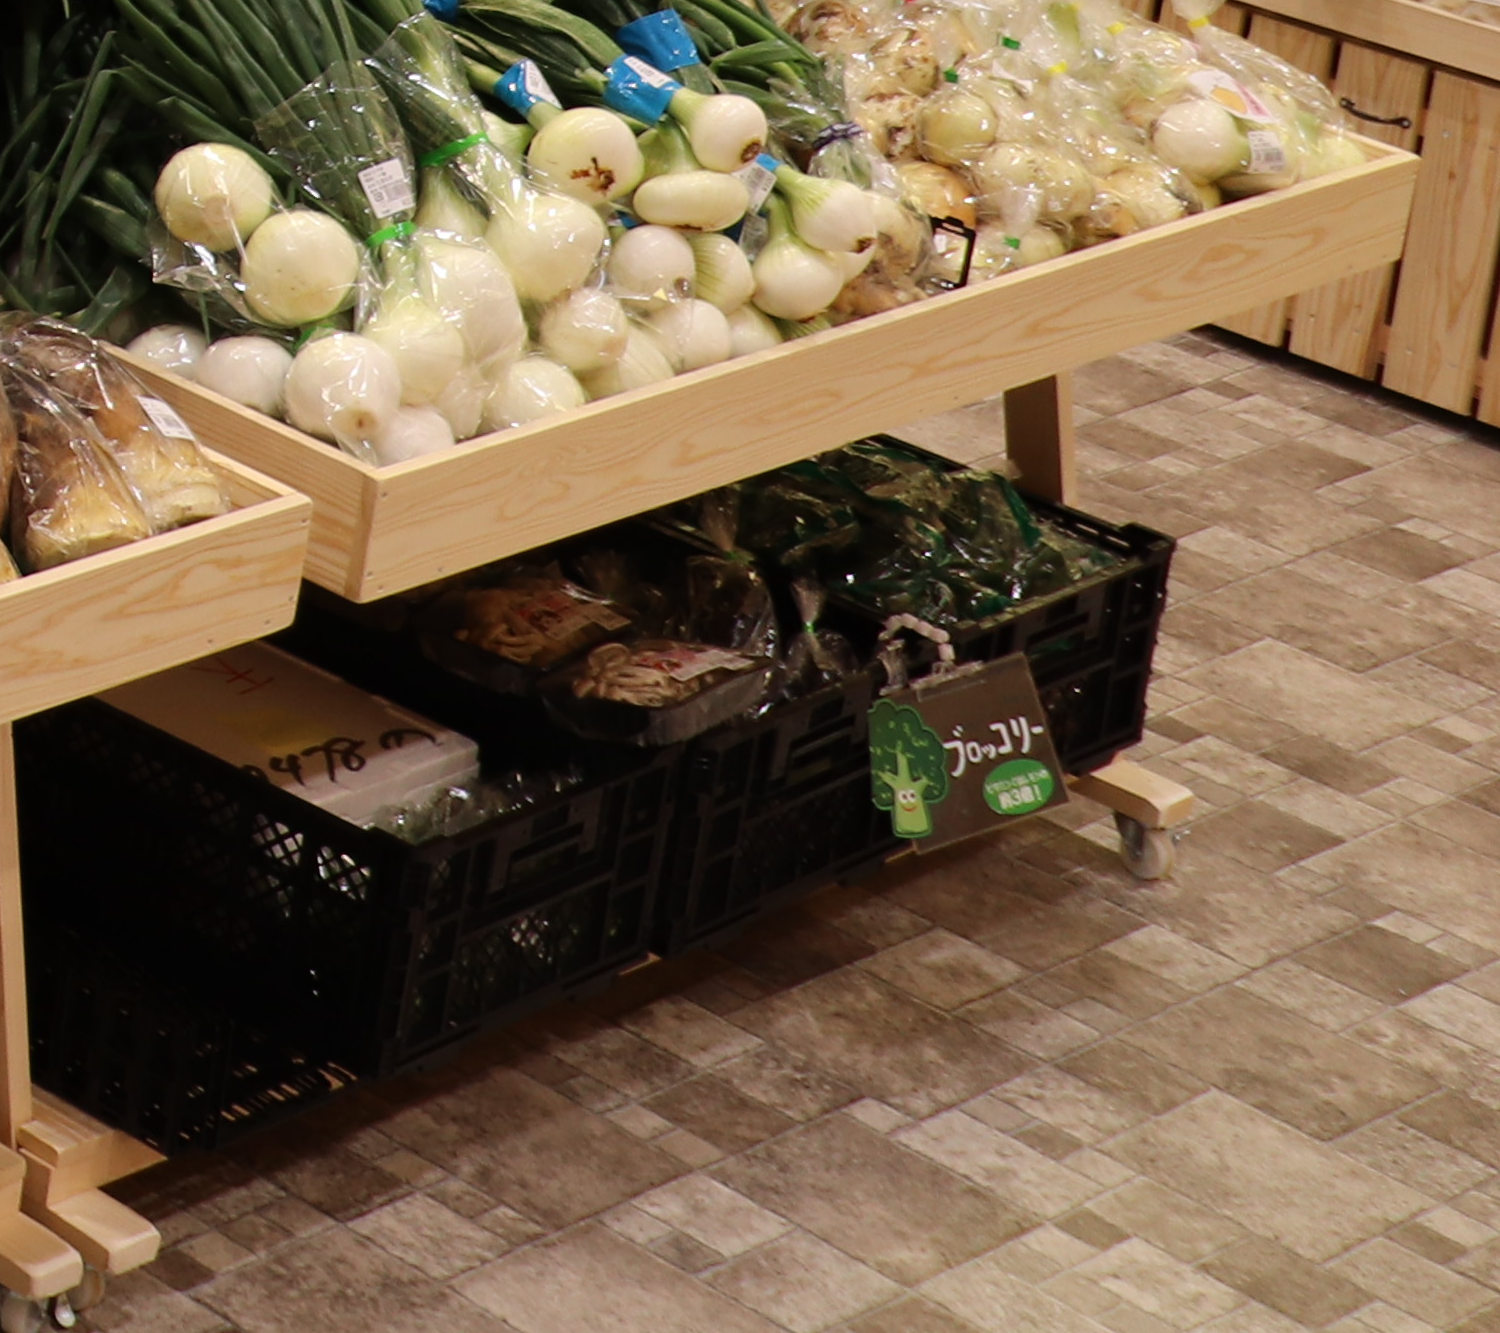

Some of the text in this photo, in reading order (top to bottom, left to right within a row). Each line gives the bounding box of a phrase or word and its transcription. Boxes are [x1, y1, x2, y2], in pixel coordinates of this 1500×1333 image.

[942, 716, 1044, 777] ブロッコリー
